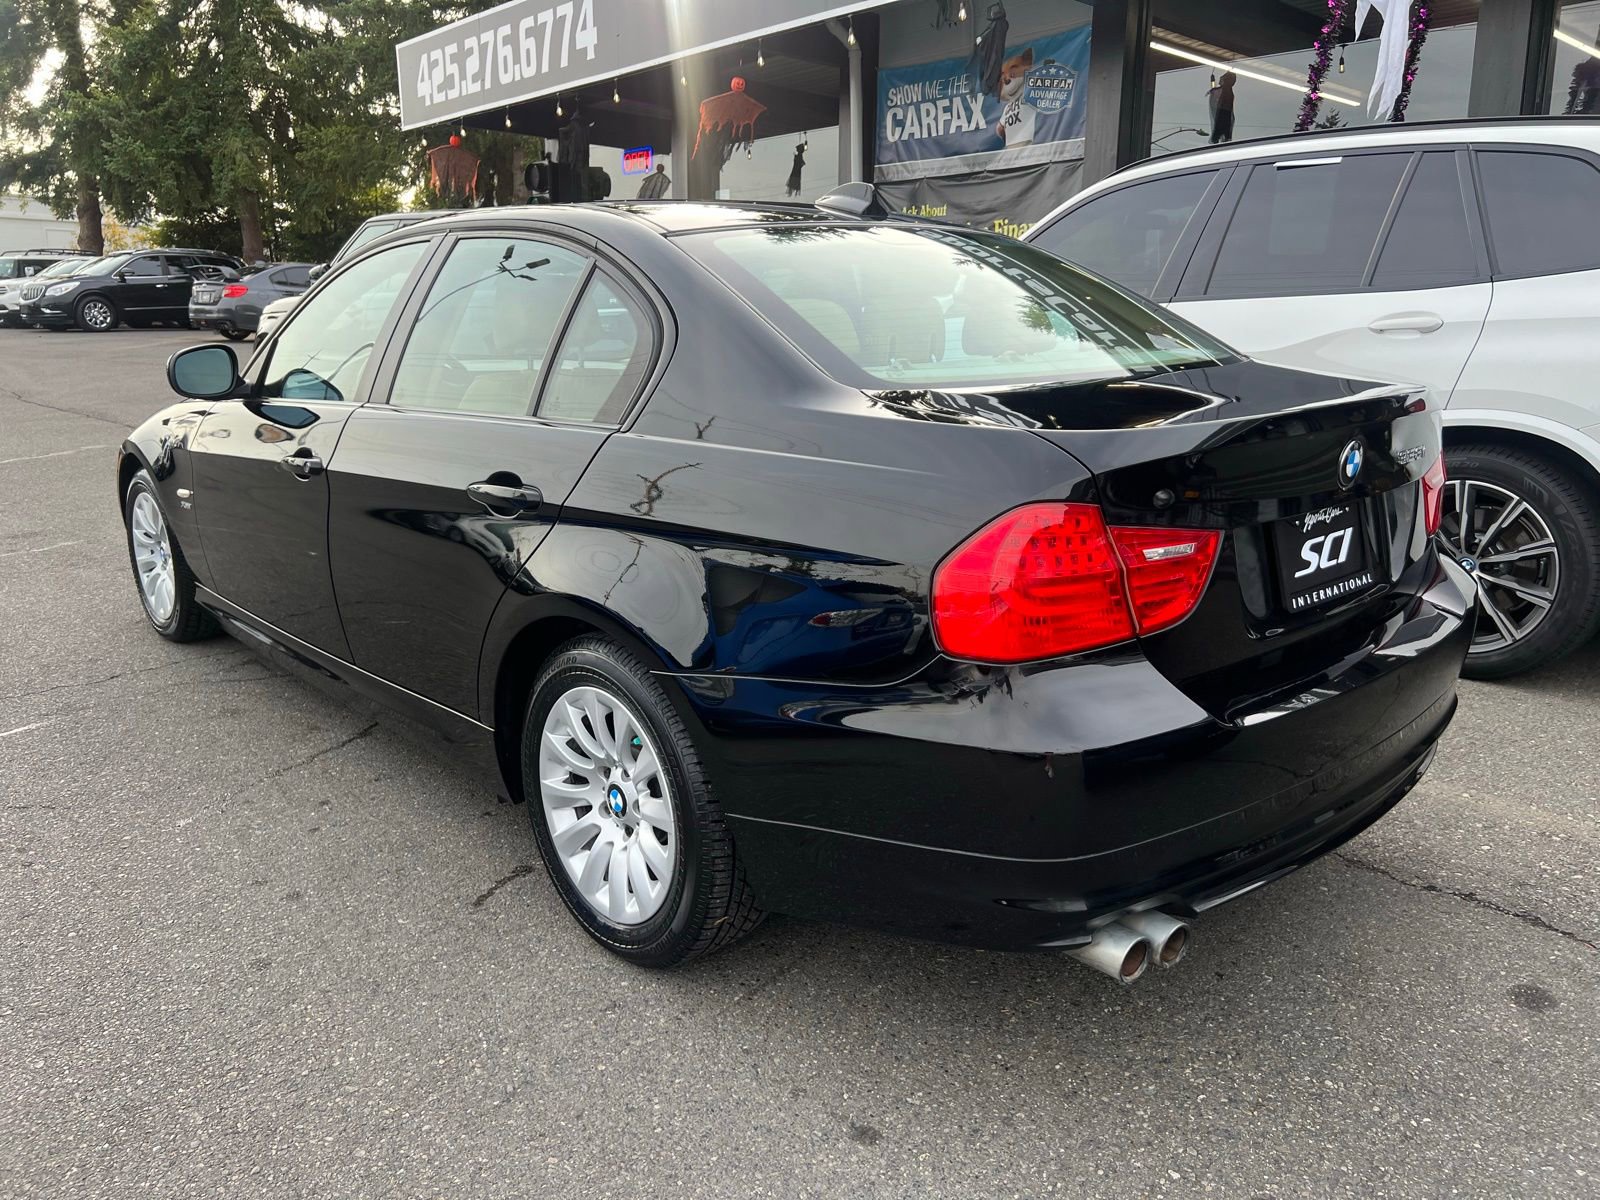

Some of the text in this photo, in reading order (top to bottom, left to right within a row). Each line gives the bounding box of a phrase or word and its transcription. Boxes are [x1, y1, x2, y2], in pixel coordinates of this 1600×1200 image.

[416, 0, 598, 106] 425.276.6774
[887, 73, 972, 107] SHOW ME THE
[1029, 89, 1068, 100] ADVANTAGE
[1036, 99, 1062, 109] DEALER
[886, 93, 987, 143] CARFAX
[920, 203, 948, 217] About
[993, 218, 1038, 239] Fina
[1294, 527, 1353, 578] SCI
[1292, 573, 1372, 609] INTERNATIONAL
